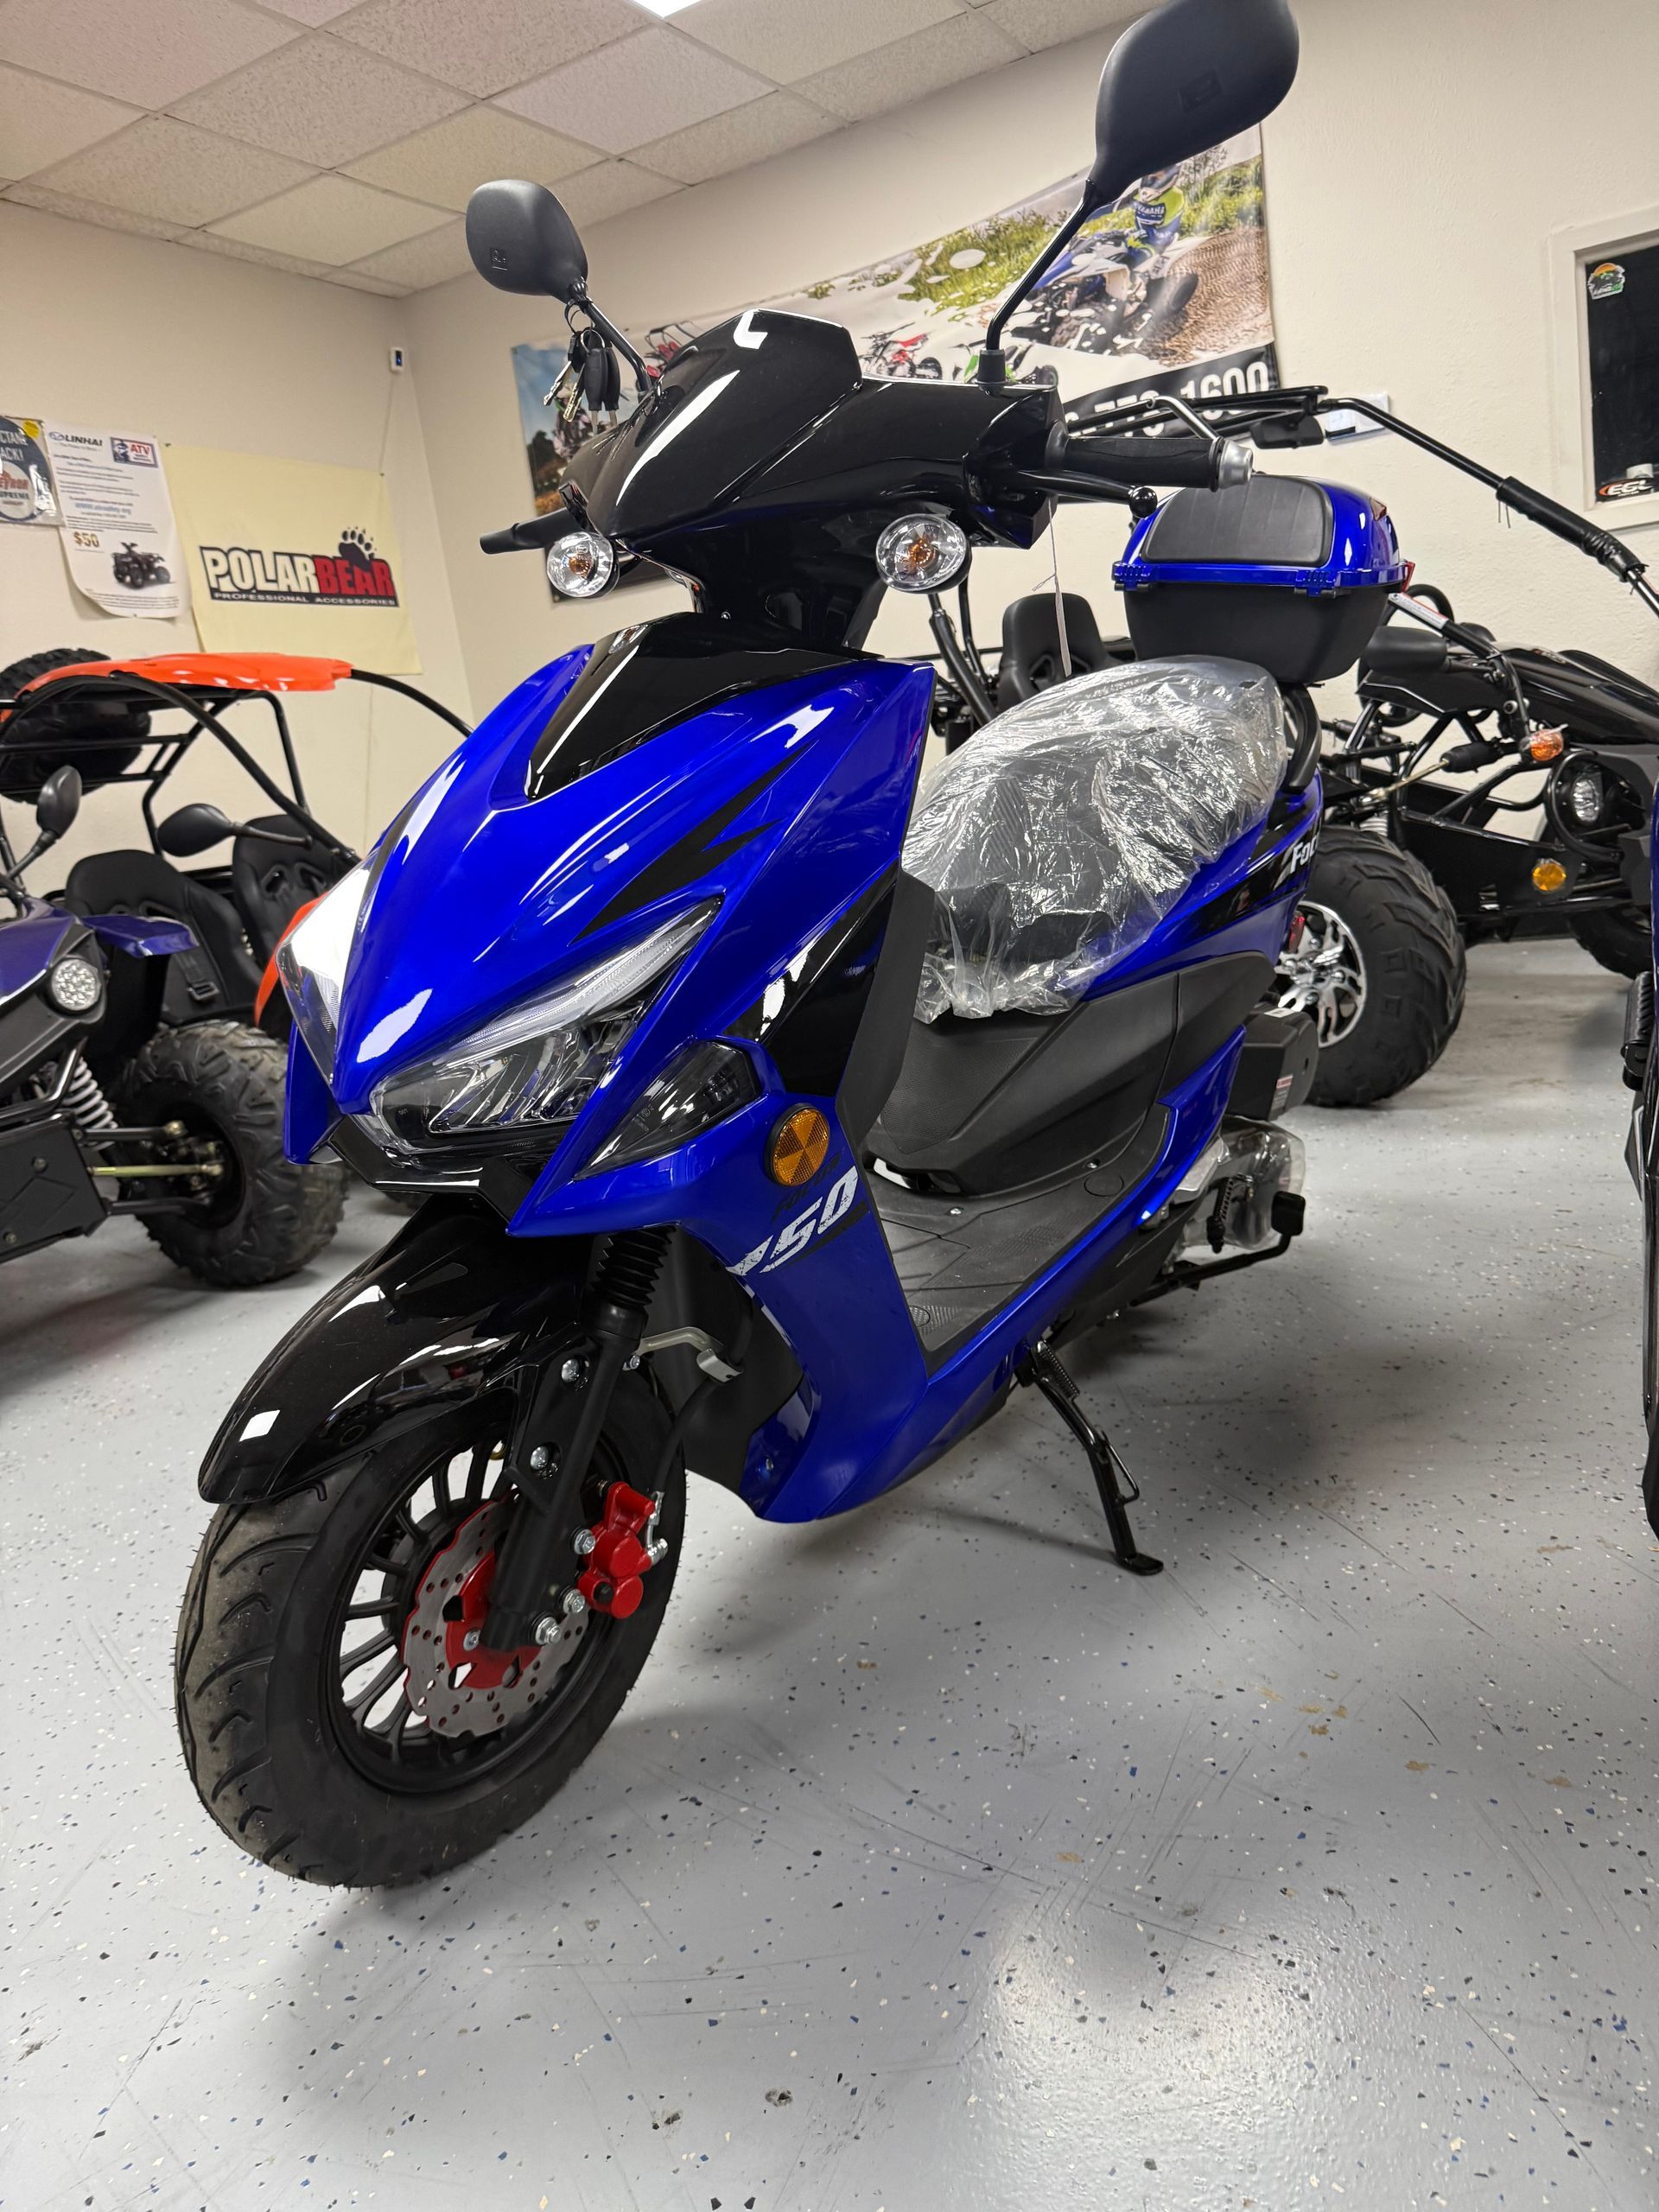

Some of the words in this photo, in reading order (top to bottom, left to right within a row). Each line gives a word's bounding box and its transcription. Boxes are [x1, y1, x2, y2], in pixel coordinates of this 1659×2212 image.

[65, 434, 103, 447] LINHAI
[130, 443, 150, 455] ATV
[73, 531, 100, 548] $50
[214, 592, 309, 603] PROFESSIONAL
